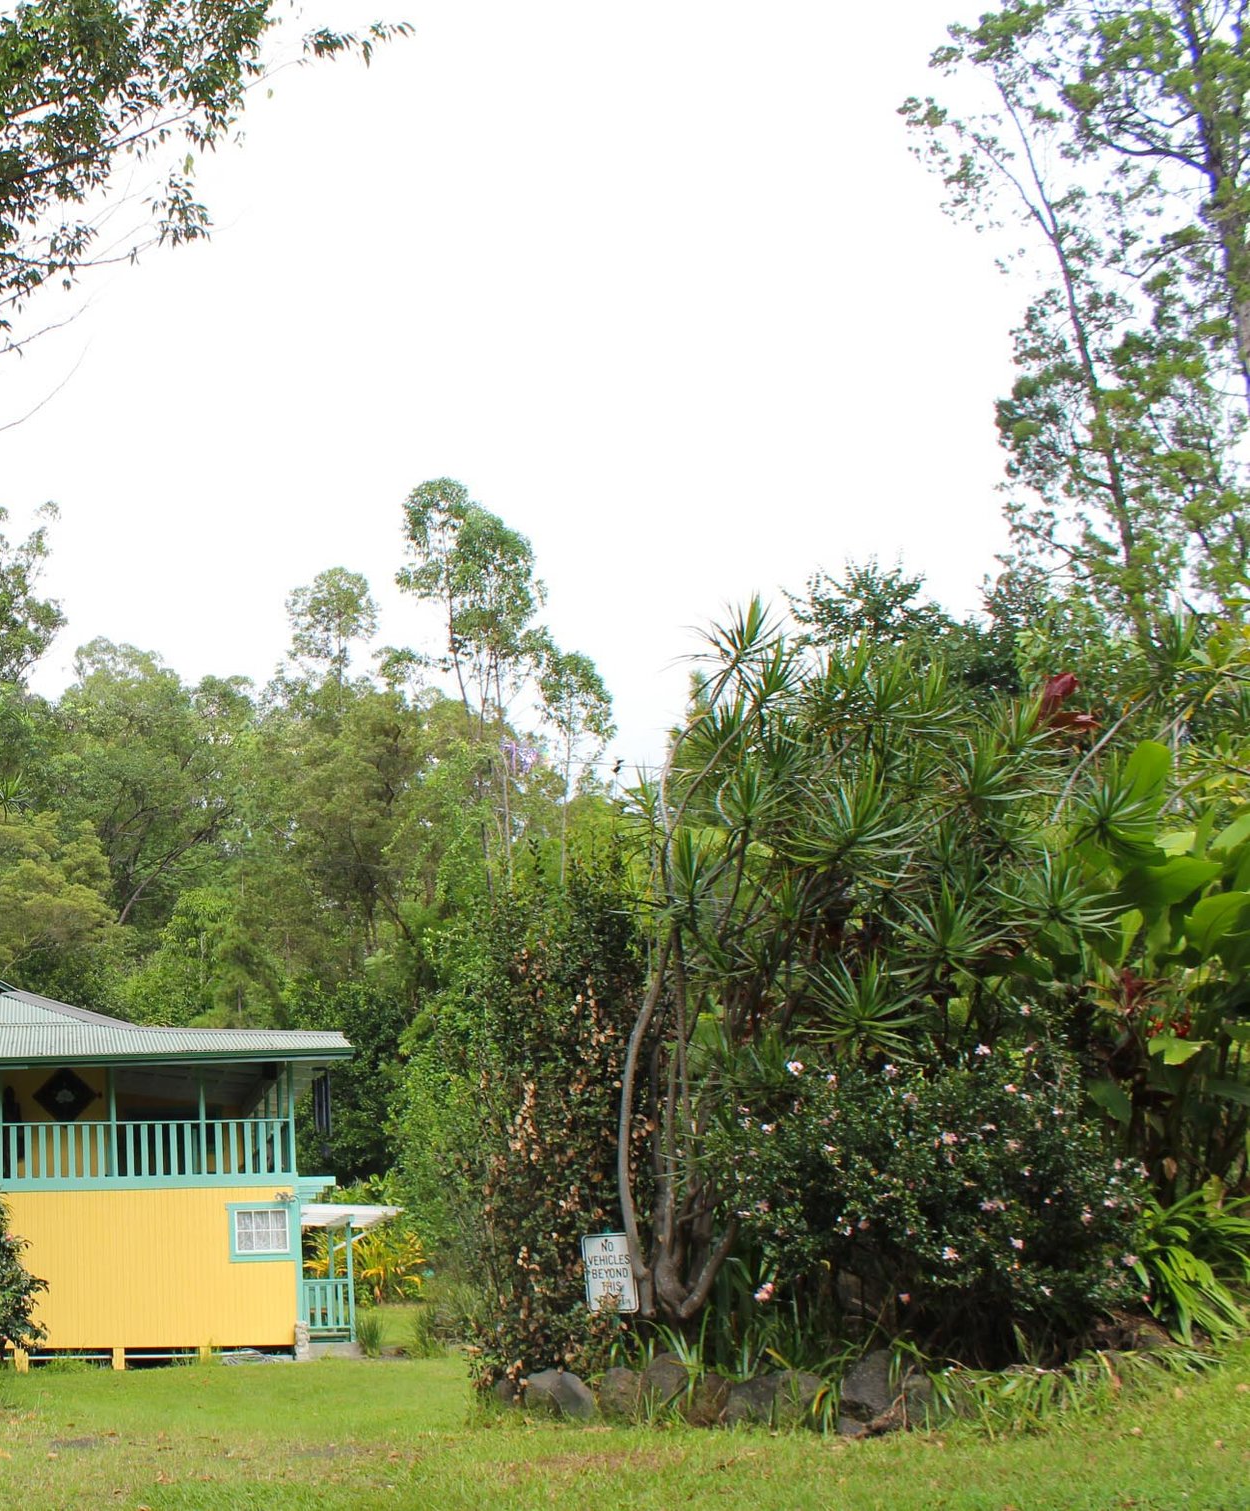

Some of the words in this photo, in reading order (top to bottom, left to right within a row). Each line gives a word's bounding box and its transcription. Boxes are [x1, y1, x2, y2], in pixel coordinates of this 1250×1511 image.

[601, 1242, 614, 1252] NO
[588, 1254, 630, 1265] VEHICLES
[592, 1268, 628, 1279] BEYOND
